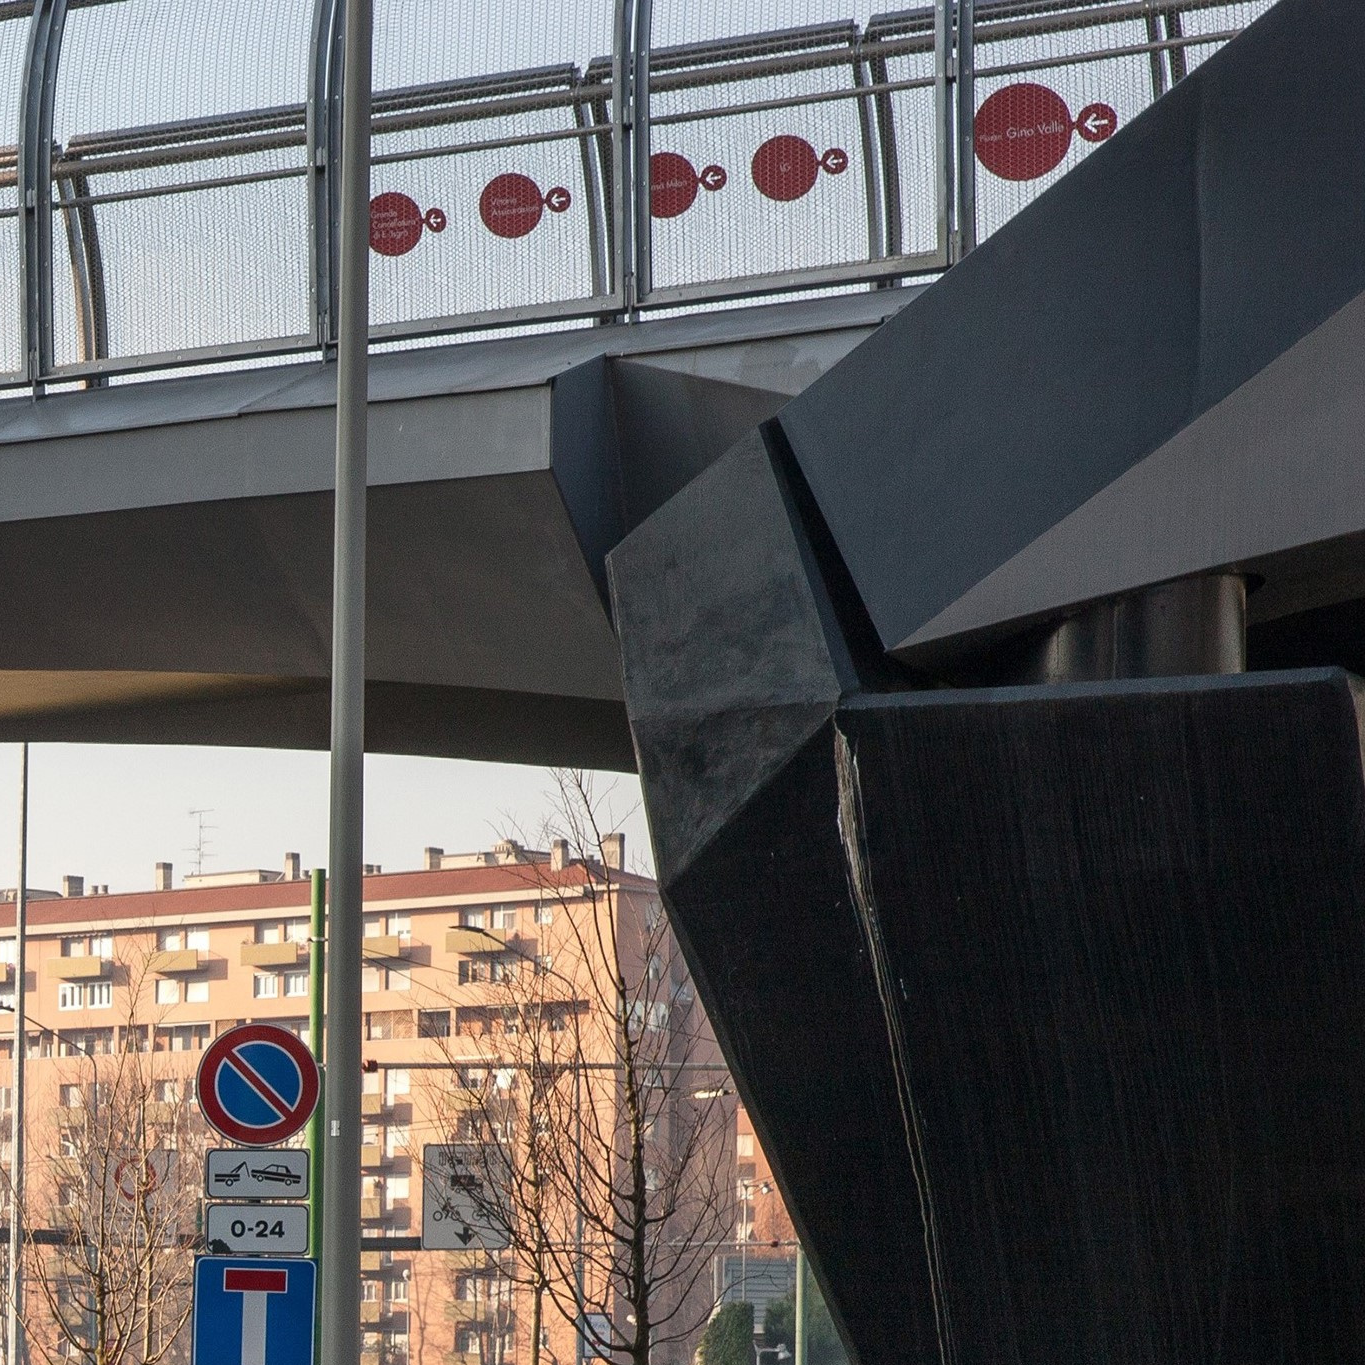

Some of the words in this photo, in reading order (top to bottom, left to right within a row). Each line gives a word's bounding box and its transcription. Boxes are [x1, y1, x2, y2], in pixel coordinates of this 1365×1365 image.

[1006, 126, 1034, 139] Gino
[1037, 120, 1065, 135] Valle
[230, 1219, 286, 1239] 0-24
